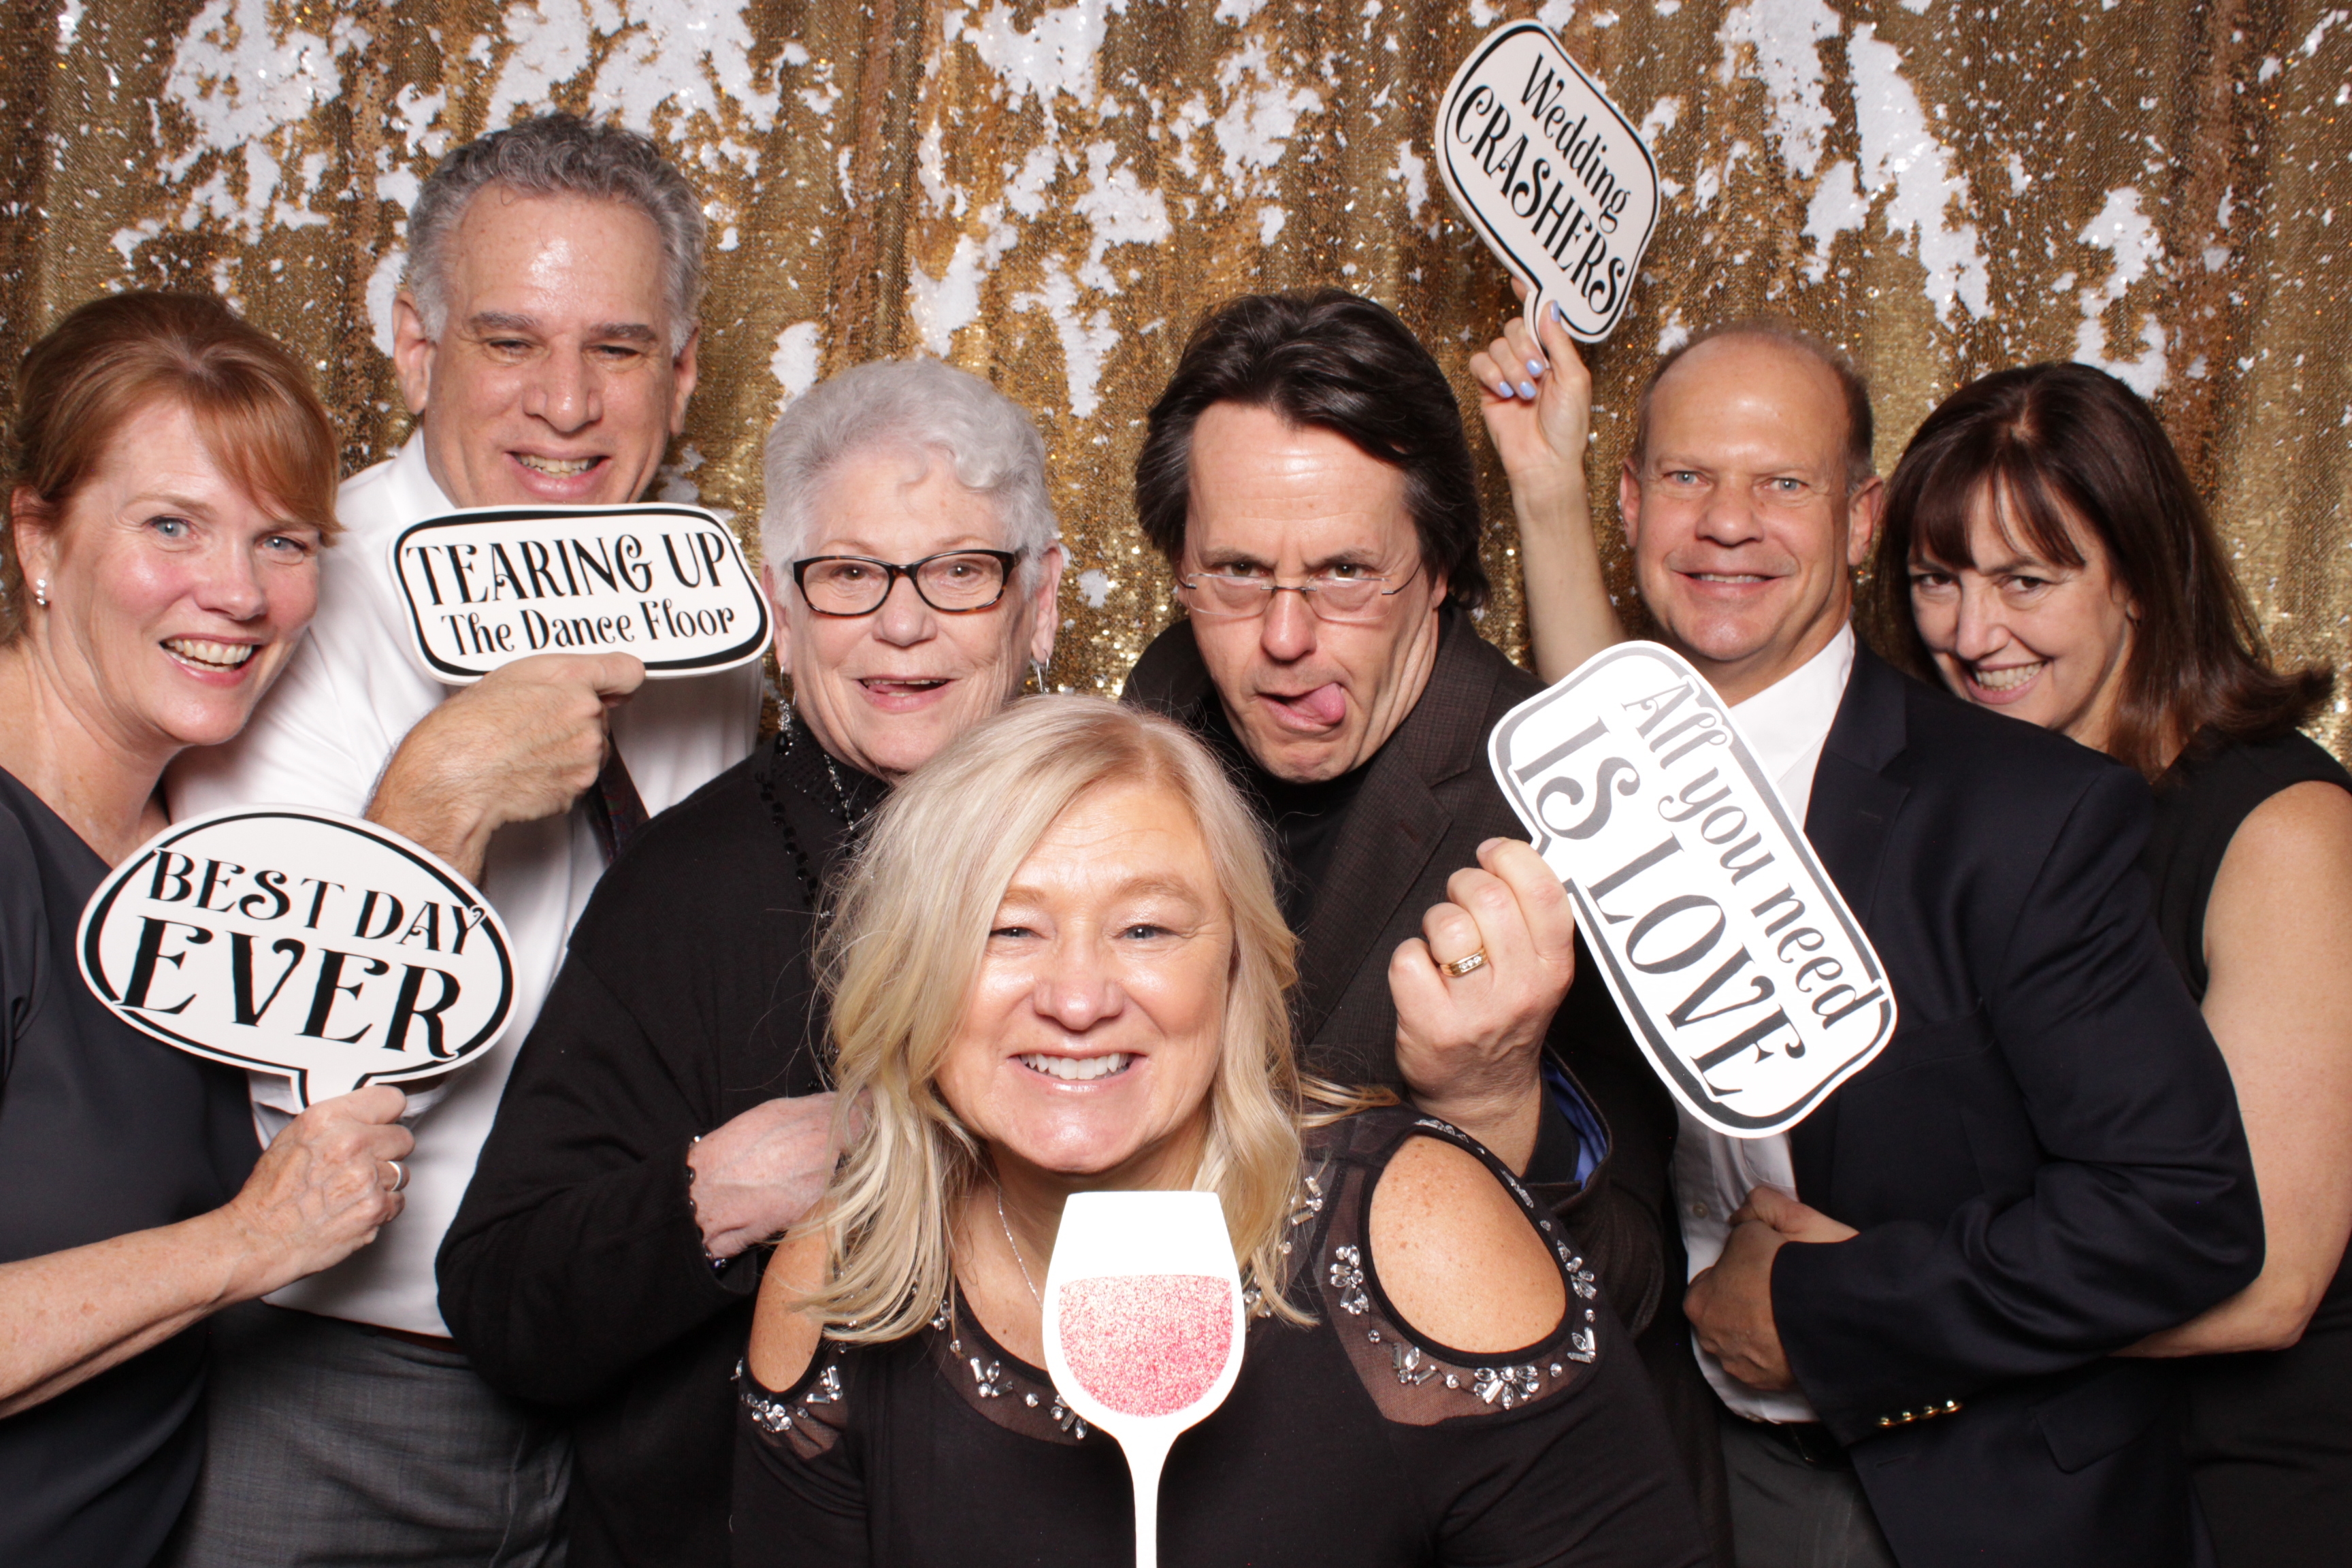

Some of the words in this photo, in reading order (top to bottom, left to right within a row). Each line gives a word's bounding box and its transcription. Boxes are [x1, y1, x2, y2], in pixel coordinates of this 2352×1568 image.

[1456, 85, 1624, 314] CRASHERS
[1520, 52, 1631, 233] Wedding
[406, 534, 653, 606] TEARING
[660, 532, 724, 588] UP
[441, 612, 514, 655] The
[519, 608, 635, 650] Dance
[638, 598, 734, 640] Floor
[1620, 681, 1728, 770] All
[1657, 767, 1776, 886] you
[146, 848, 345, 930] BEST
[354, 889, 485, 956] DAY
[1513, 716, 1641, 840] IS
[1585, 831, 1806, 1096] LOVE
[1750, 883, 1885, 1030] need
[114, 915, 461, 1060] EVER
